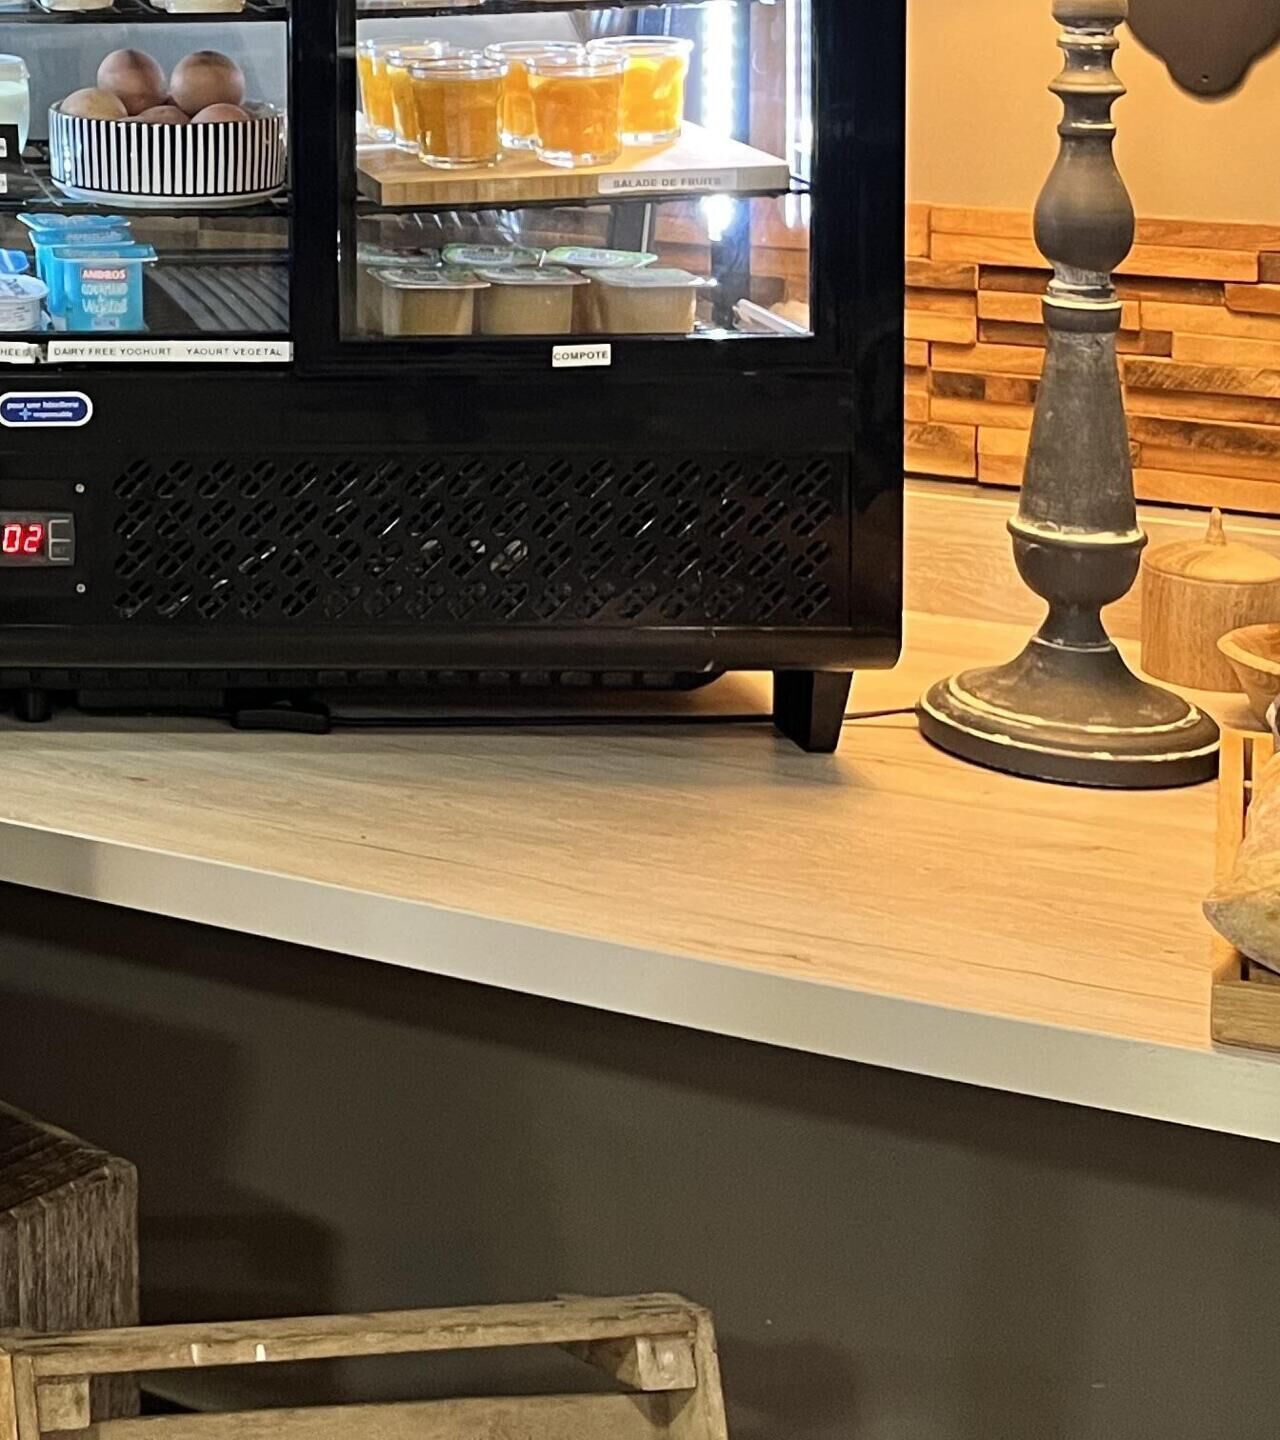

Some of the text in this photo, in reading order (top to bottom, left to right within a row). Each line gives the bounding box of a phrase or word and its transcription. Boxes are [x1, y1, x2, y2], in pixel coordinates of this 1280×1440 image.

[613, 178, 657, 189] SALADE
[661, 177, 677, 187] DE
[53, 346, 283, 358] DAIRY FREE YOGHURT YAOURT VEGETAL
[553, 349, 609, 363] COMPOTE
[2, 523, 43, 553] 02
